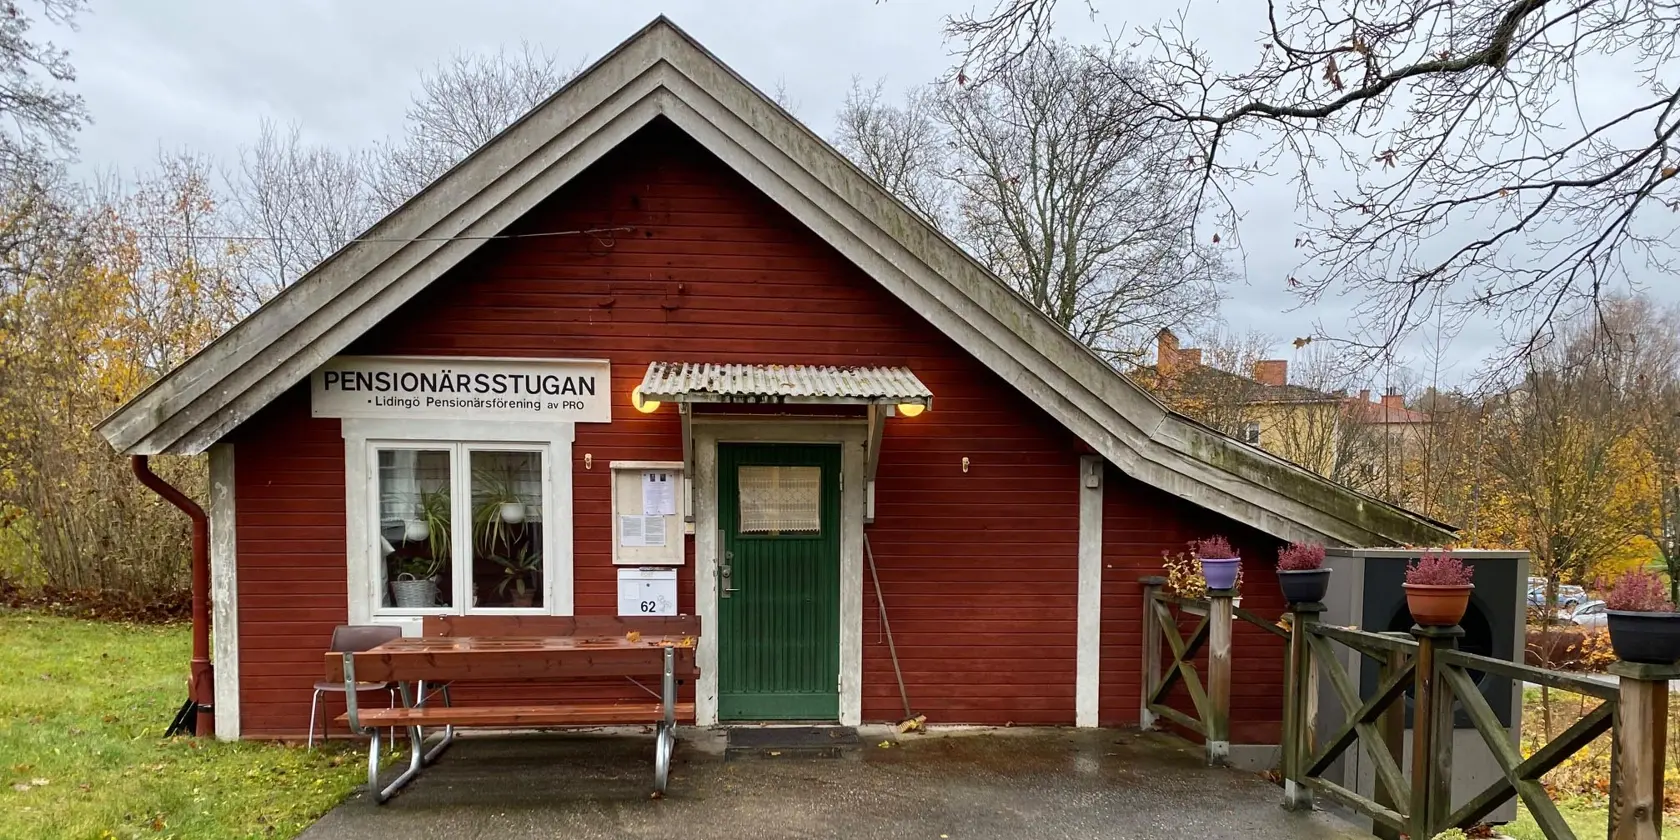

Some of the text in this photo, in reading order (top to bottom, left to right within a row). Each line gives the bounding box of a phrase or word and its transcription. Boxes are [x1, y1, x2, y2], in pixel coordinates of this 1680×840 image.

[324, 370, 595, 396] PENSIONÄRSSTUGAN
[375, 396, 420, 408] Lidingö
[426, 397, 541, 411] Pensionärsförening
[562, 401, 585, 410] PRO
[641, 601, 656, 612] 62
